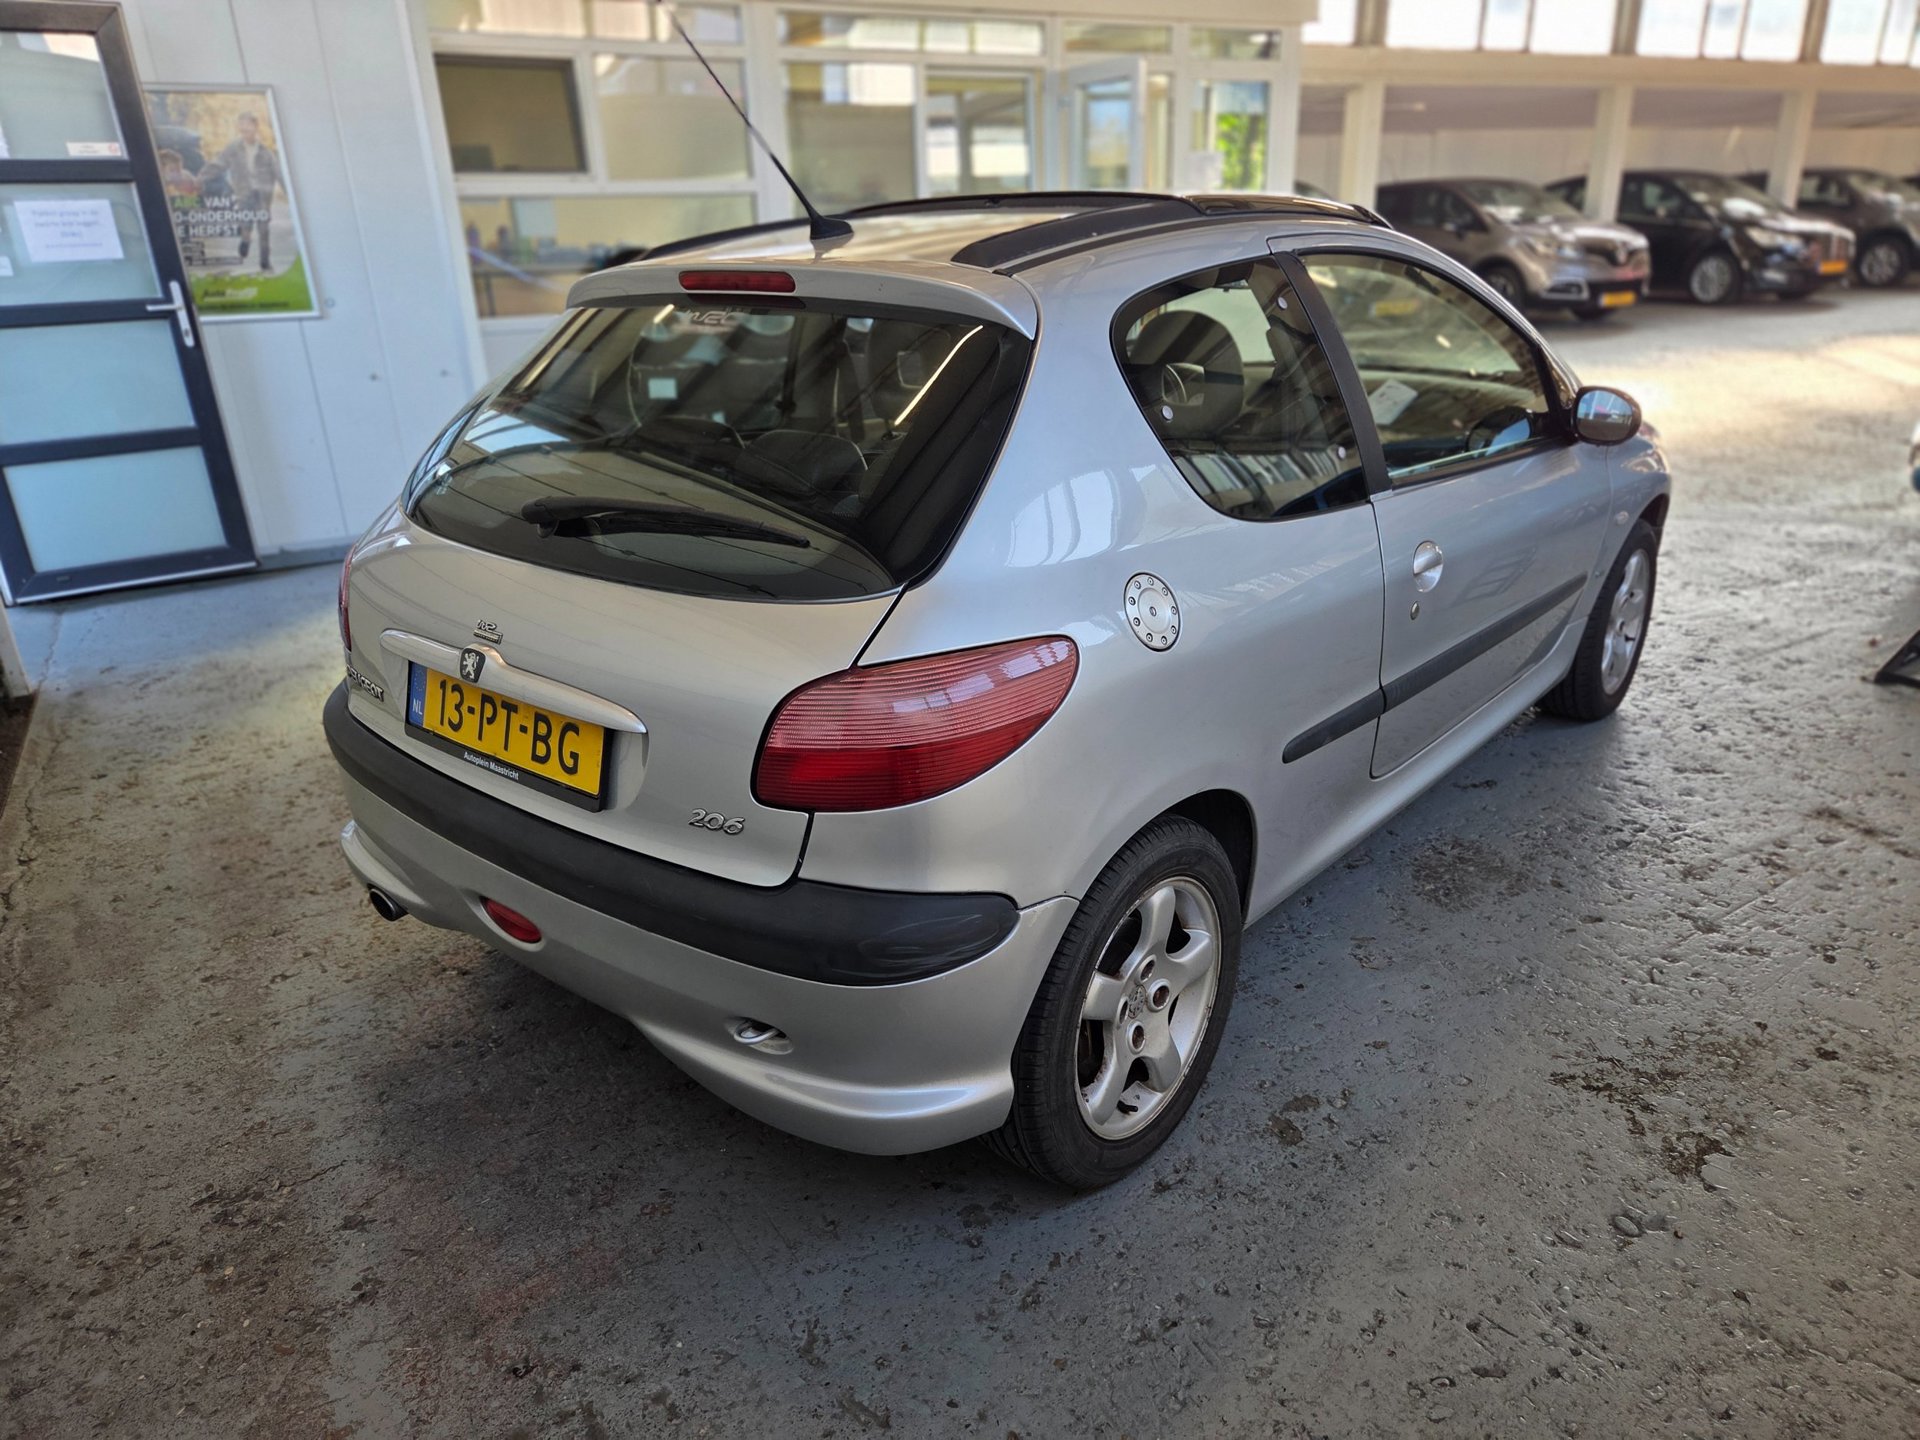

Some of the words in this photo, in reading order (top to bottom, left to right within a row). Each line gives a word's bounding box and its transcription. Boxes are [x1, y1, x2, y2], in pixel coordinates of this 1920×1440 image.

[204, 196, 231, 209] VAN
[189, 224, 239, 238] HERFST
[412, 698, 424, 716] NL
[439, 679, 580, 776] 13-PT-BG
[463, 751, 490, 768] Autoplein
[489, 761, 520, 780] Maastricht
[688, 808, 746, 836] 206
